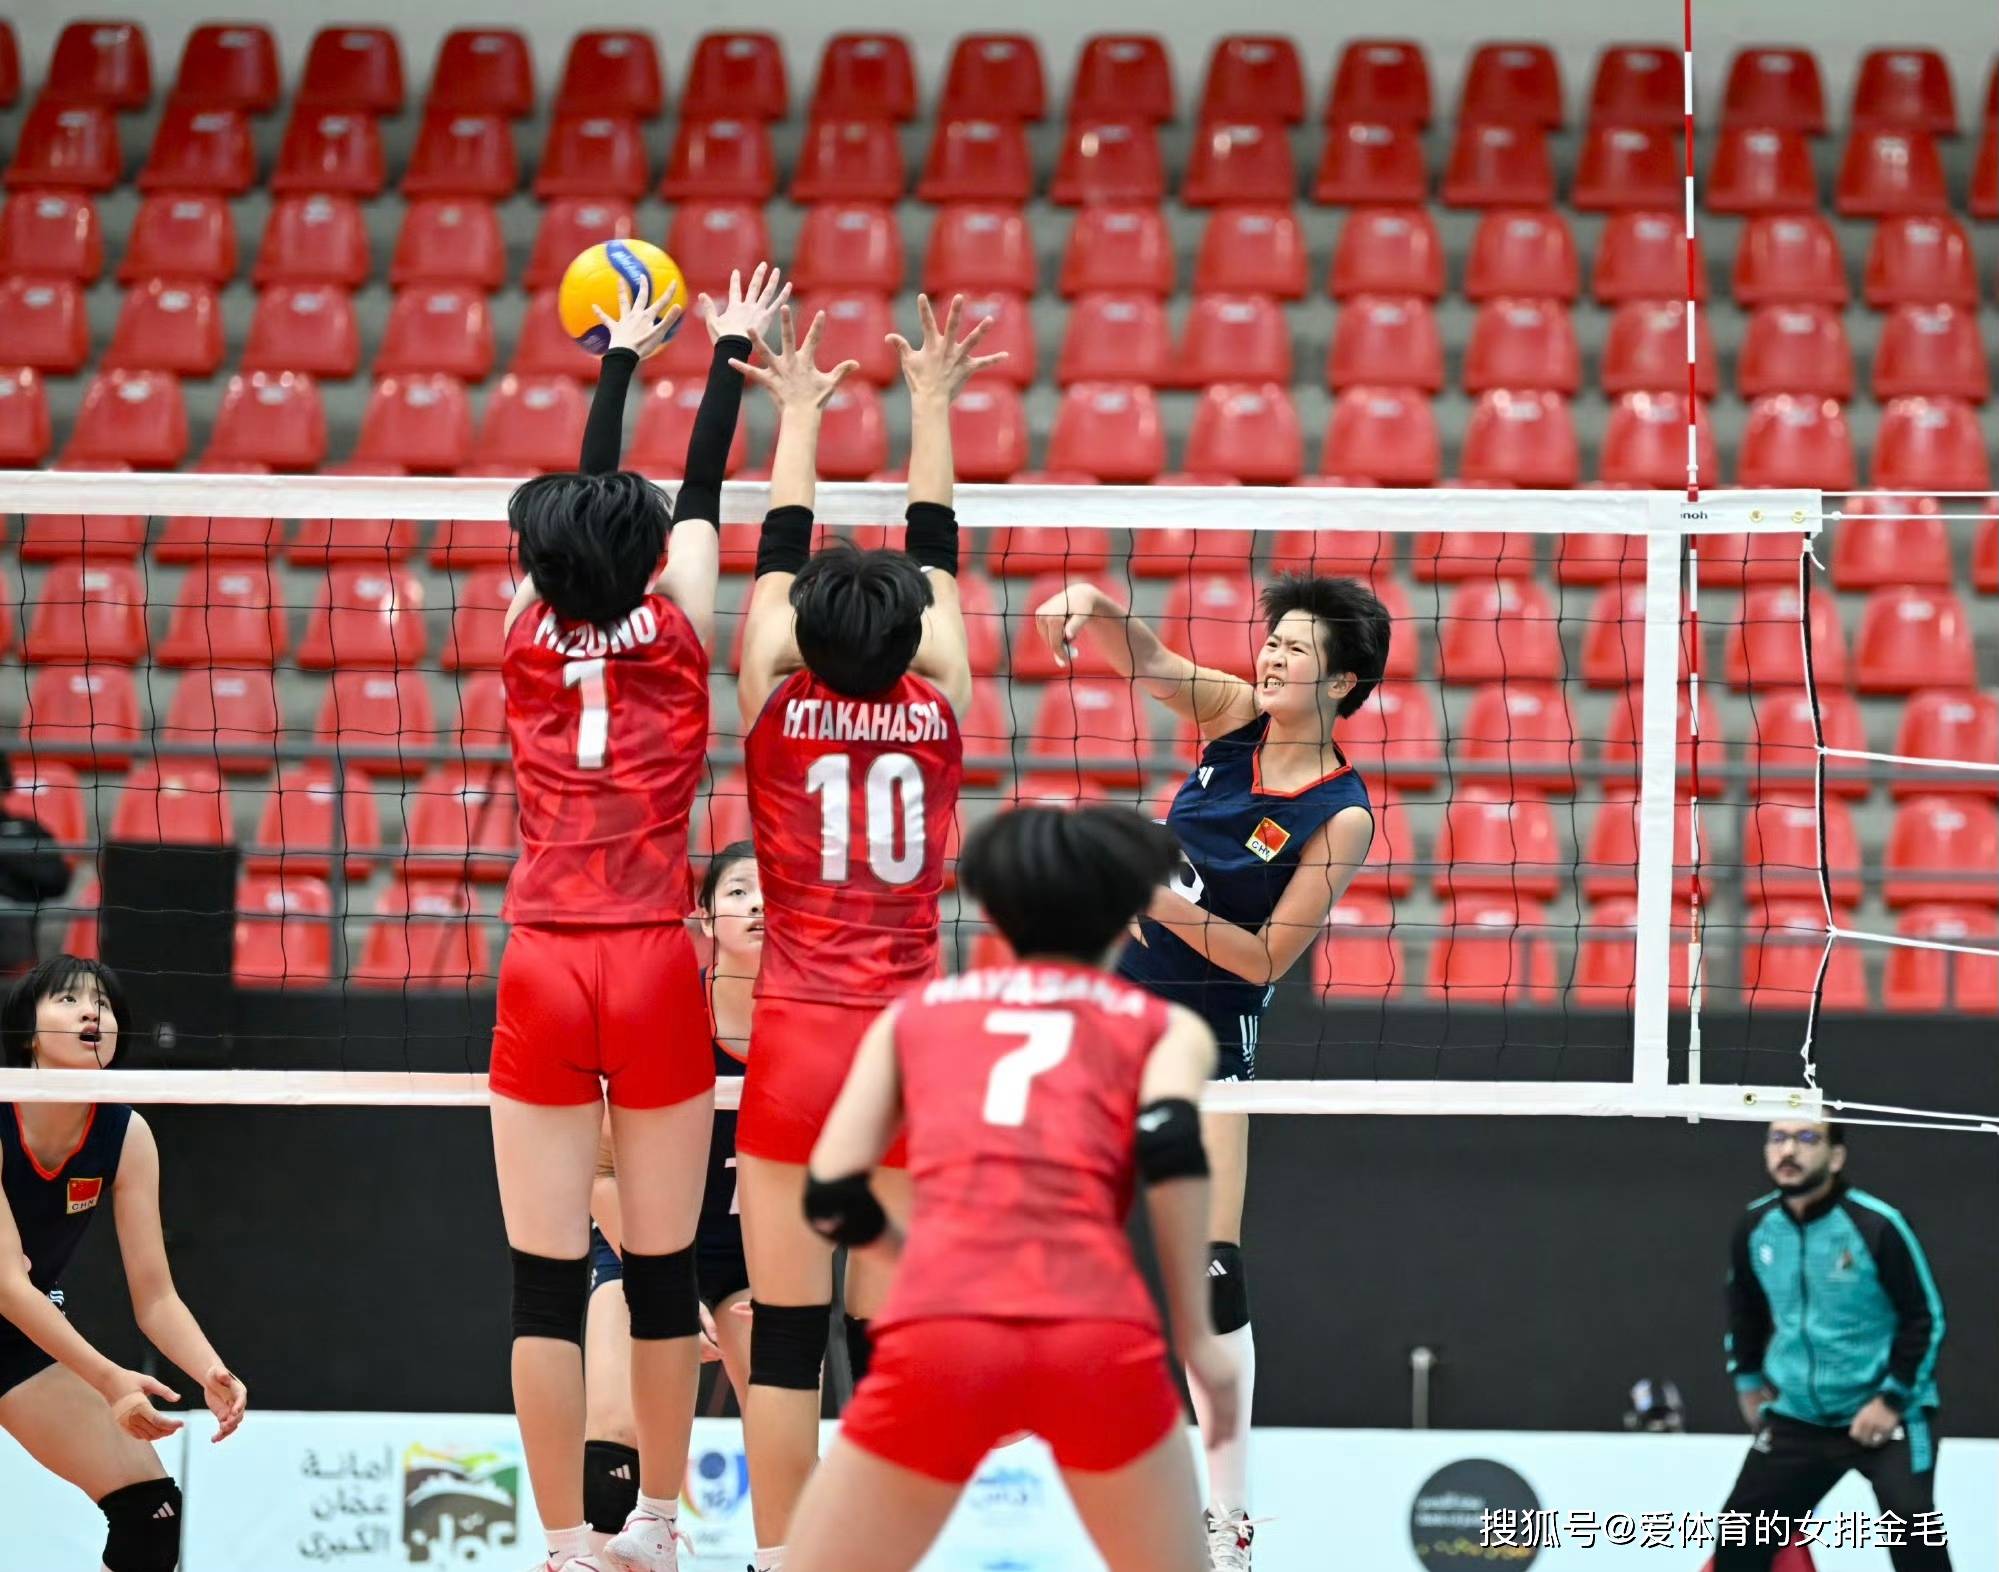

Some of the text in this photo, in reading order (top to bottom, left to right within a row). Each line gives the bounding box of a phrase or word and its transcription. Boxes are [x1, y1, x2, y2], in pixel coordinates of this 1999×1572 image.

[563, 657, 608, 768] 1
[806, 753, 925, 884] 10
[983, 1010, 1075, 1127] 7
[71, 1199, 95, 1211] CHN
